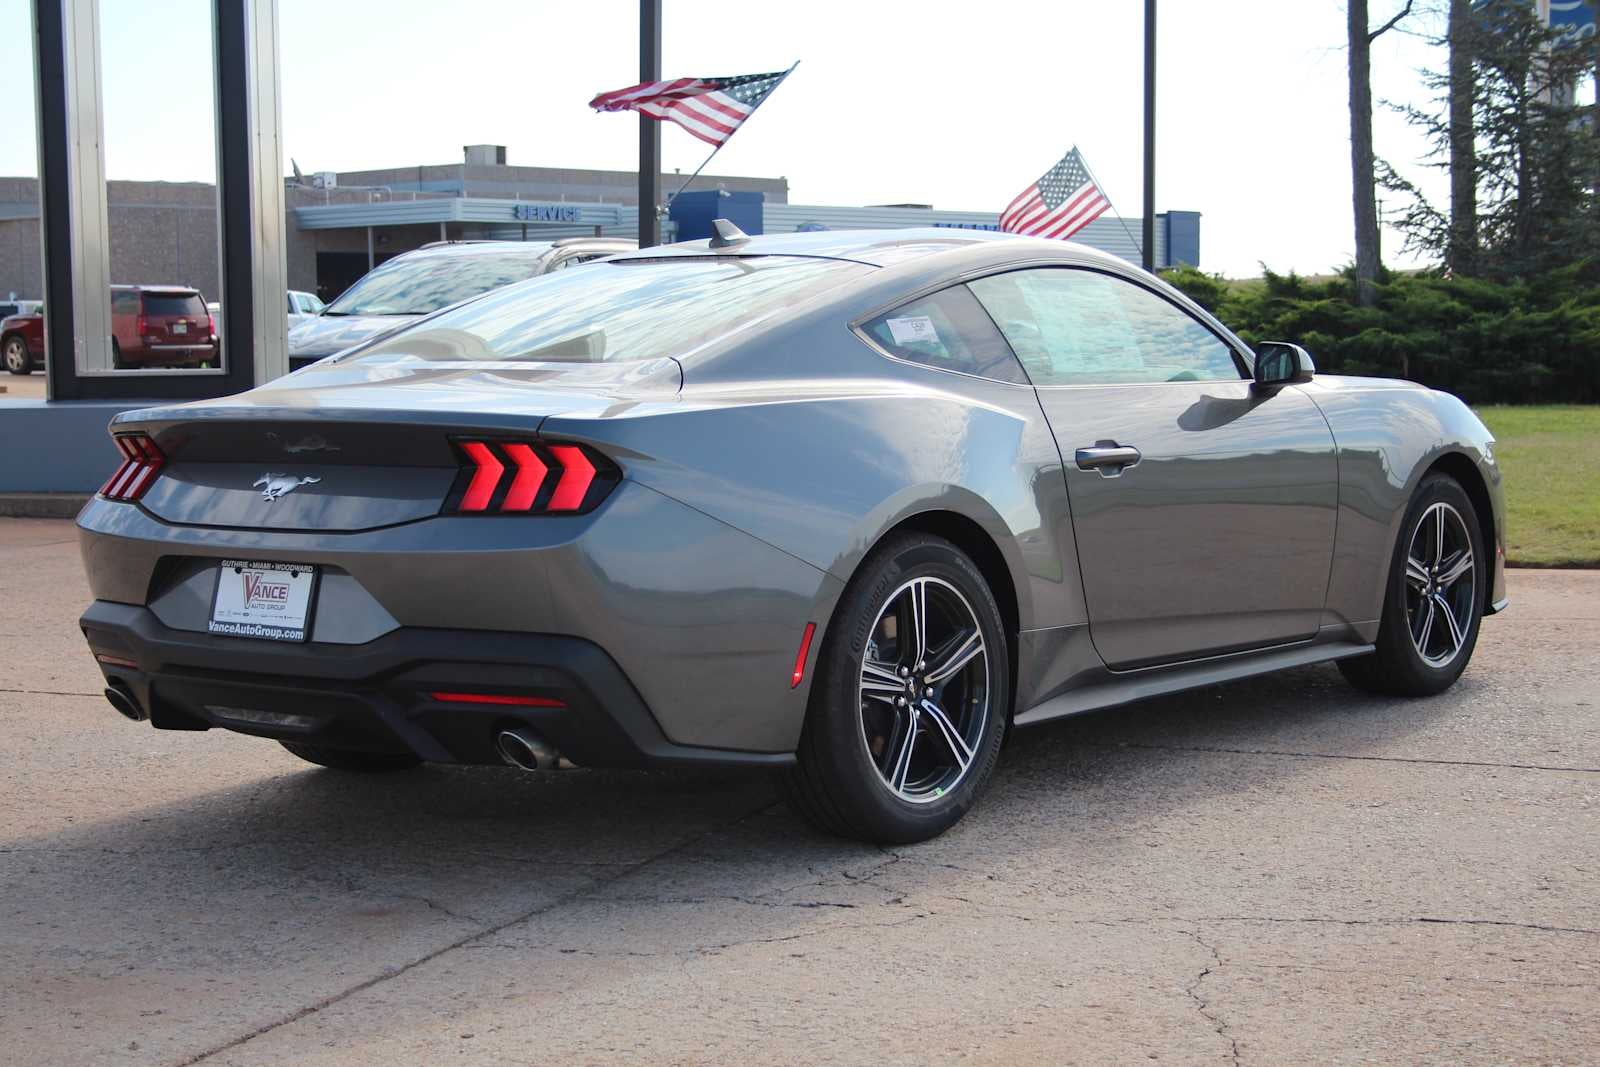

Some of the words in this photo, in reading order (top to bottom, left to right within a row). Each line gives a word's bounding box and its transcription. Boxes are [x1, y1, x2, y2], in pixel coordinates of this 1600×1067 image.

[513, 204, 581, 222] SERVICE
[221, 560, 248, 569] GUTHRIE
[275, 563, 314, 573] WOODWARD
[242, 572, 289, 609] VANCE
[208, 620, 304, 640] VanceAutoGroup.com
